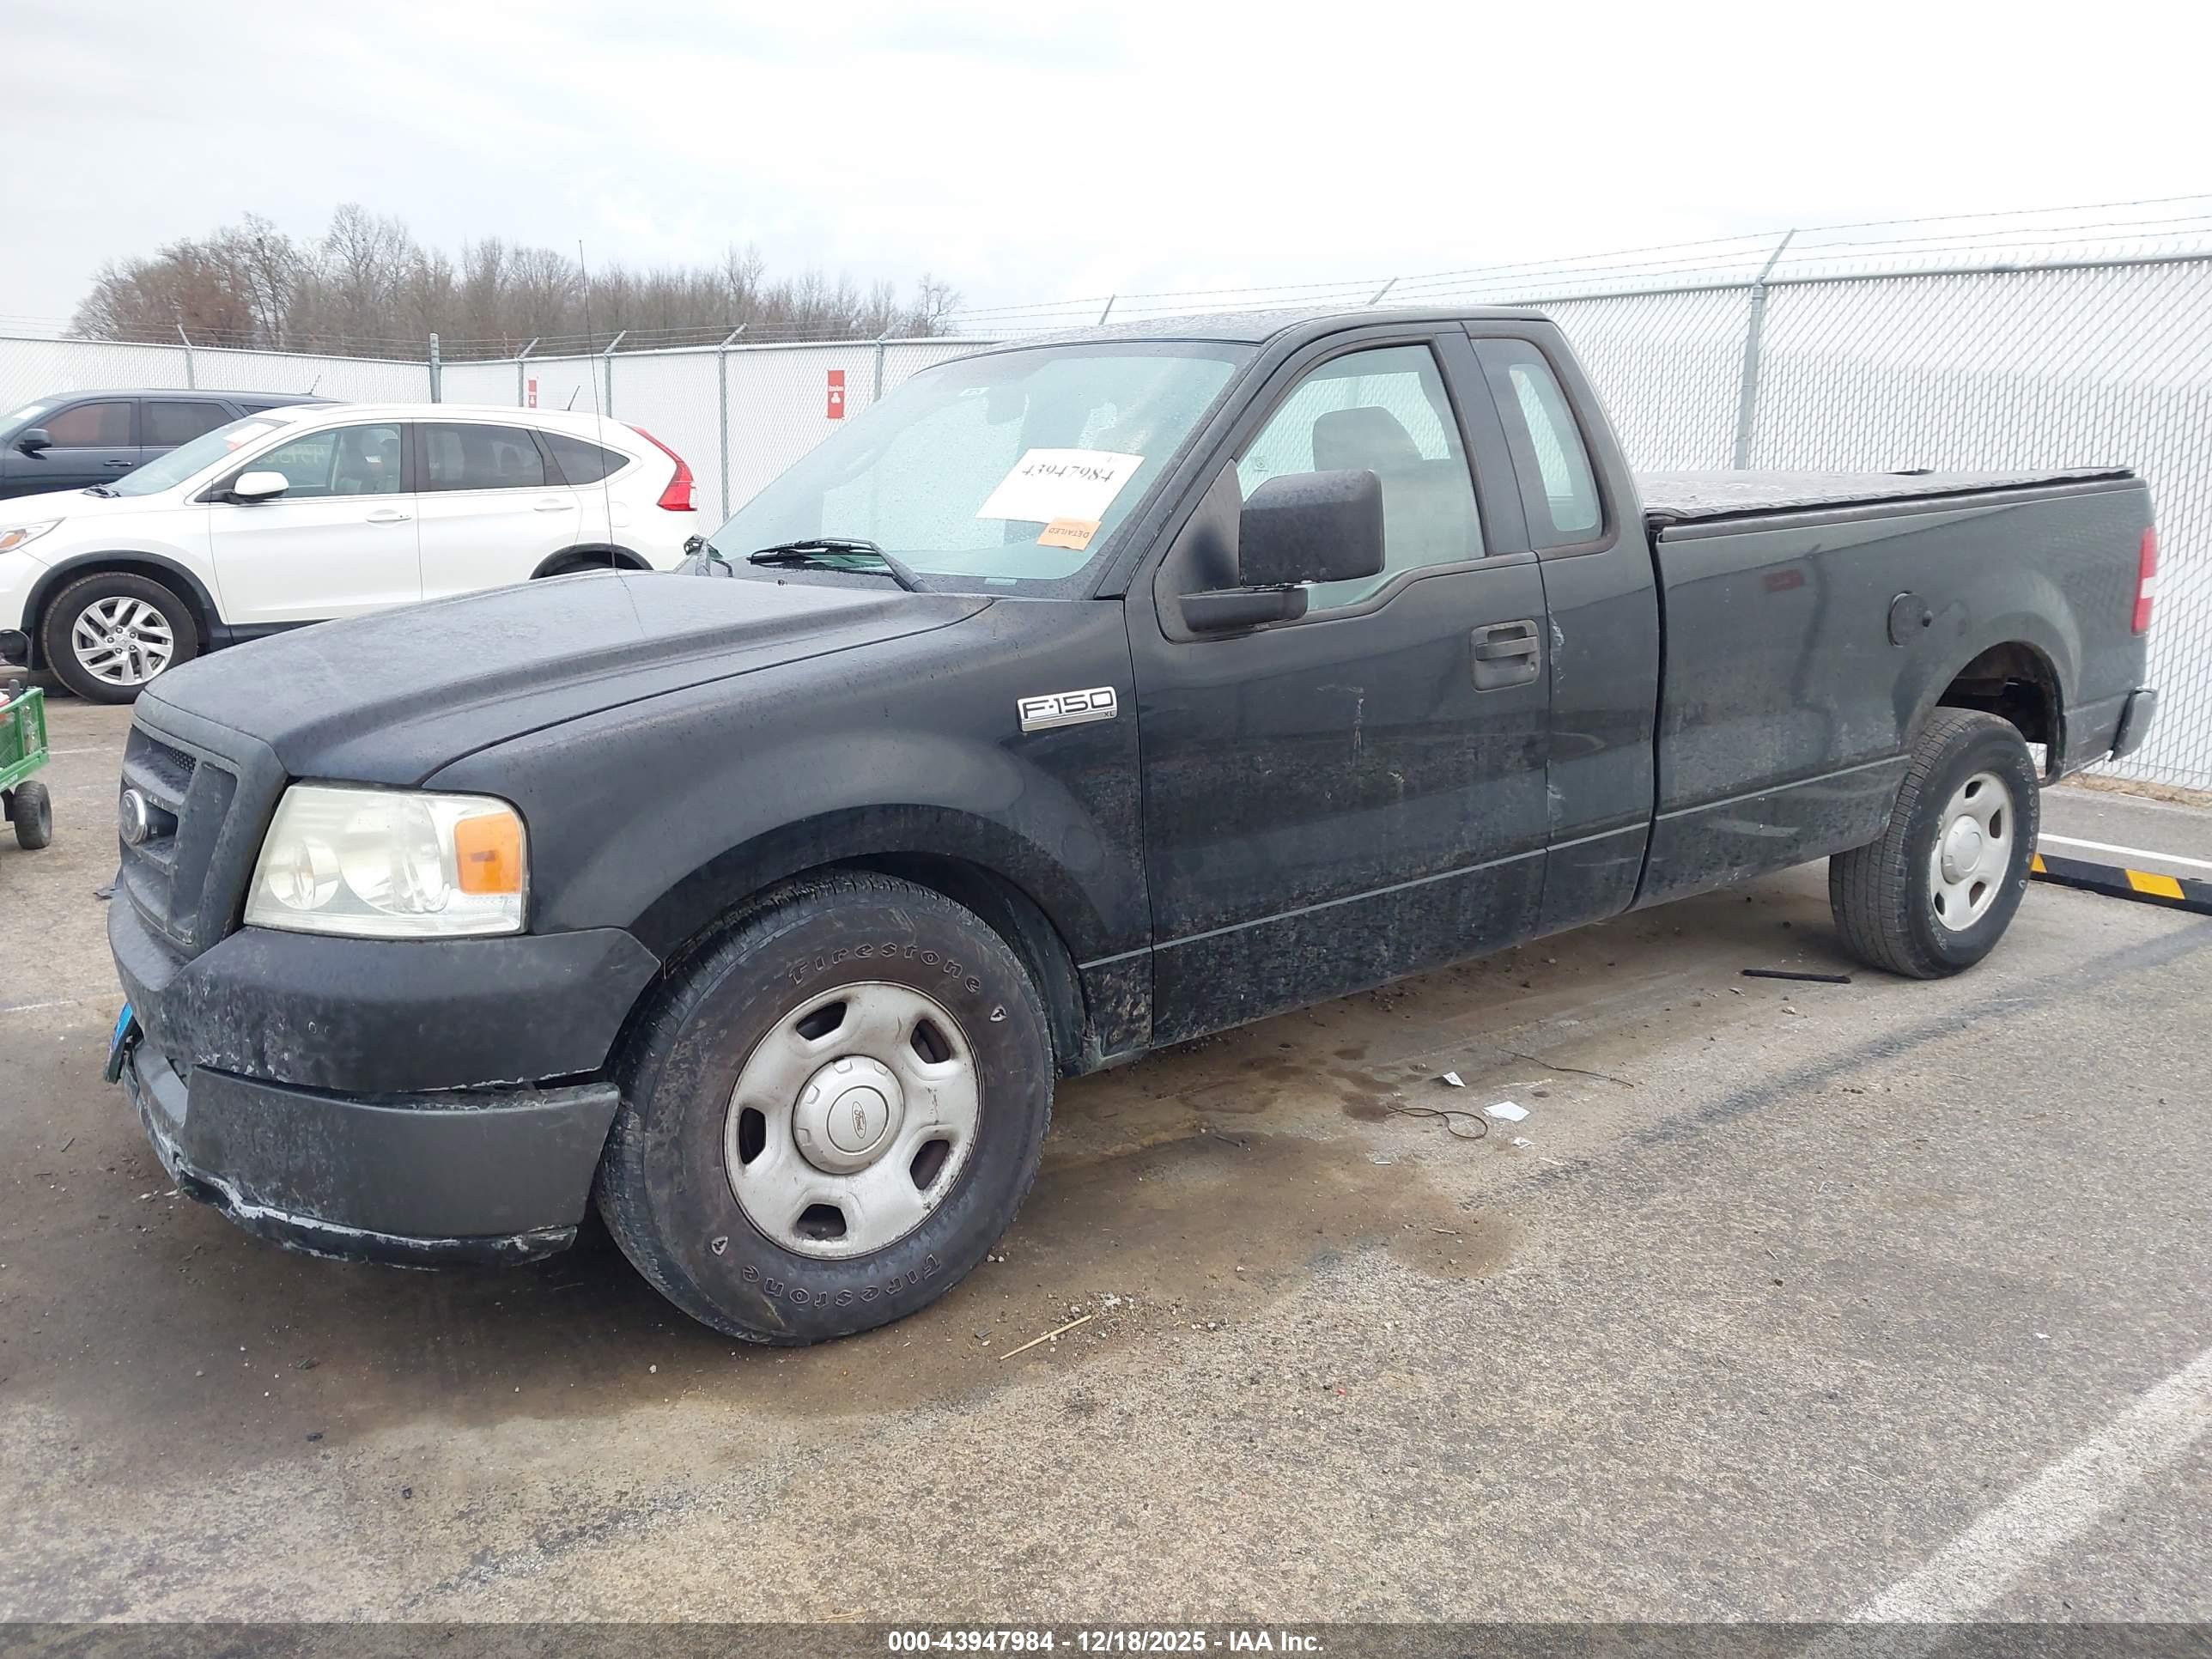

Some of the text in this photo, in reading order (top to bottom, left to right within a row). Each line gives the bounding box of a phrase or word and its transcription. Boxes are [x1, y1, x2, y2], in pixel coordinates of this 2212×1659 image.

[1021, 464, 1115, 482] 43947984
[1048, 527, 1091, 538] DETAILED
[1022, 690, 1114, 719] F-150
